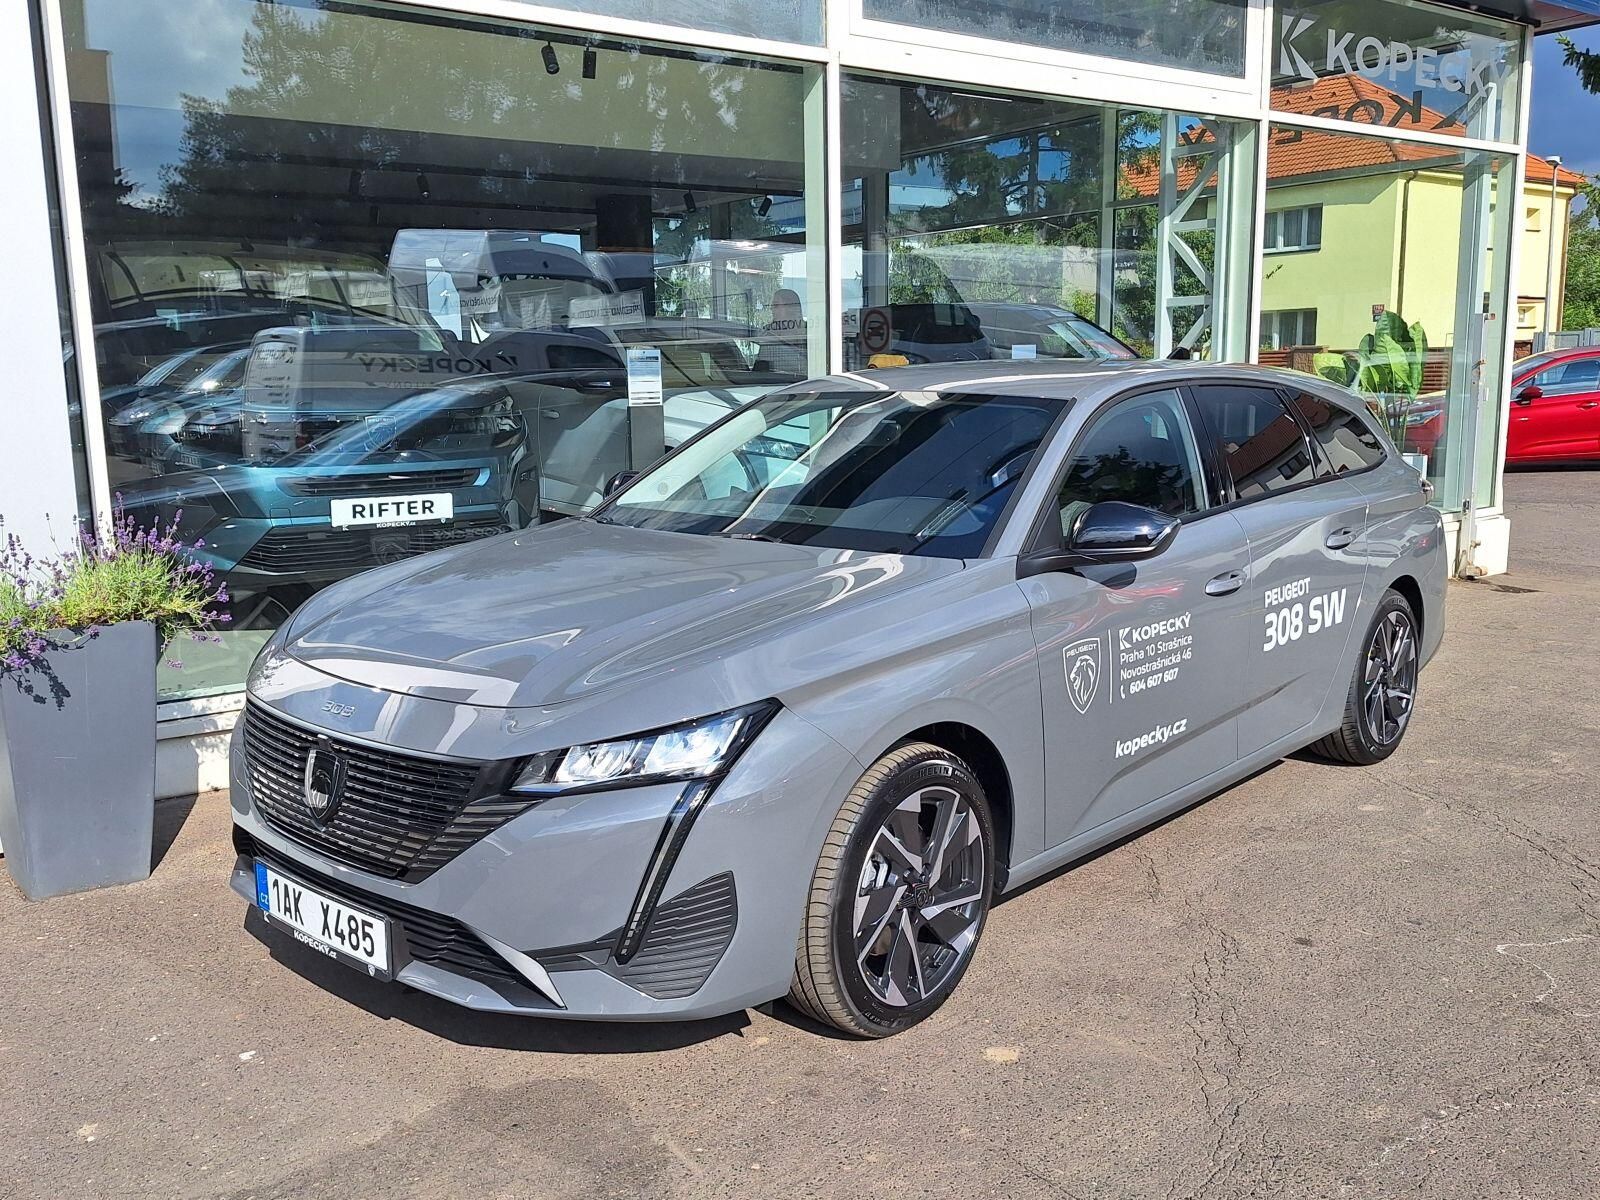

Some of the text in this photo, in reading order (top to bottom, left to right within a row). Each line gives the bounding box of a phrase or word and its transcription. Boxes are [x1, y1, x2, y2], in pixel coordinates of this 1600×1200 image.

[352, 500, 435, 519] RIFTER
[1264, 577, 1311, 608] PEUGEOT
[1132, 613, 1192, 643] KOPECKÝ
[1263, 588, 1347, 652] 308 SW
[1066, 643, 1097, 658] PEUGEOT
[1120, 633, 1193, 665] Praha 10 Strašnice
[1120, 649, 1192, 681] Novostrašnická 46
[1129, 667, 1179, 695] 604 607 607
[321, 700, 355, 717] 308
[1115, 717, 1188, 759] kopecky.cz
[260, 891, 269, 904] CZ
[272, 878, 375, 958] 1AK X485
